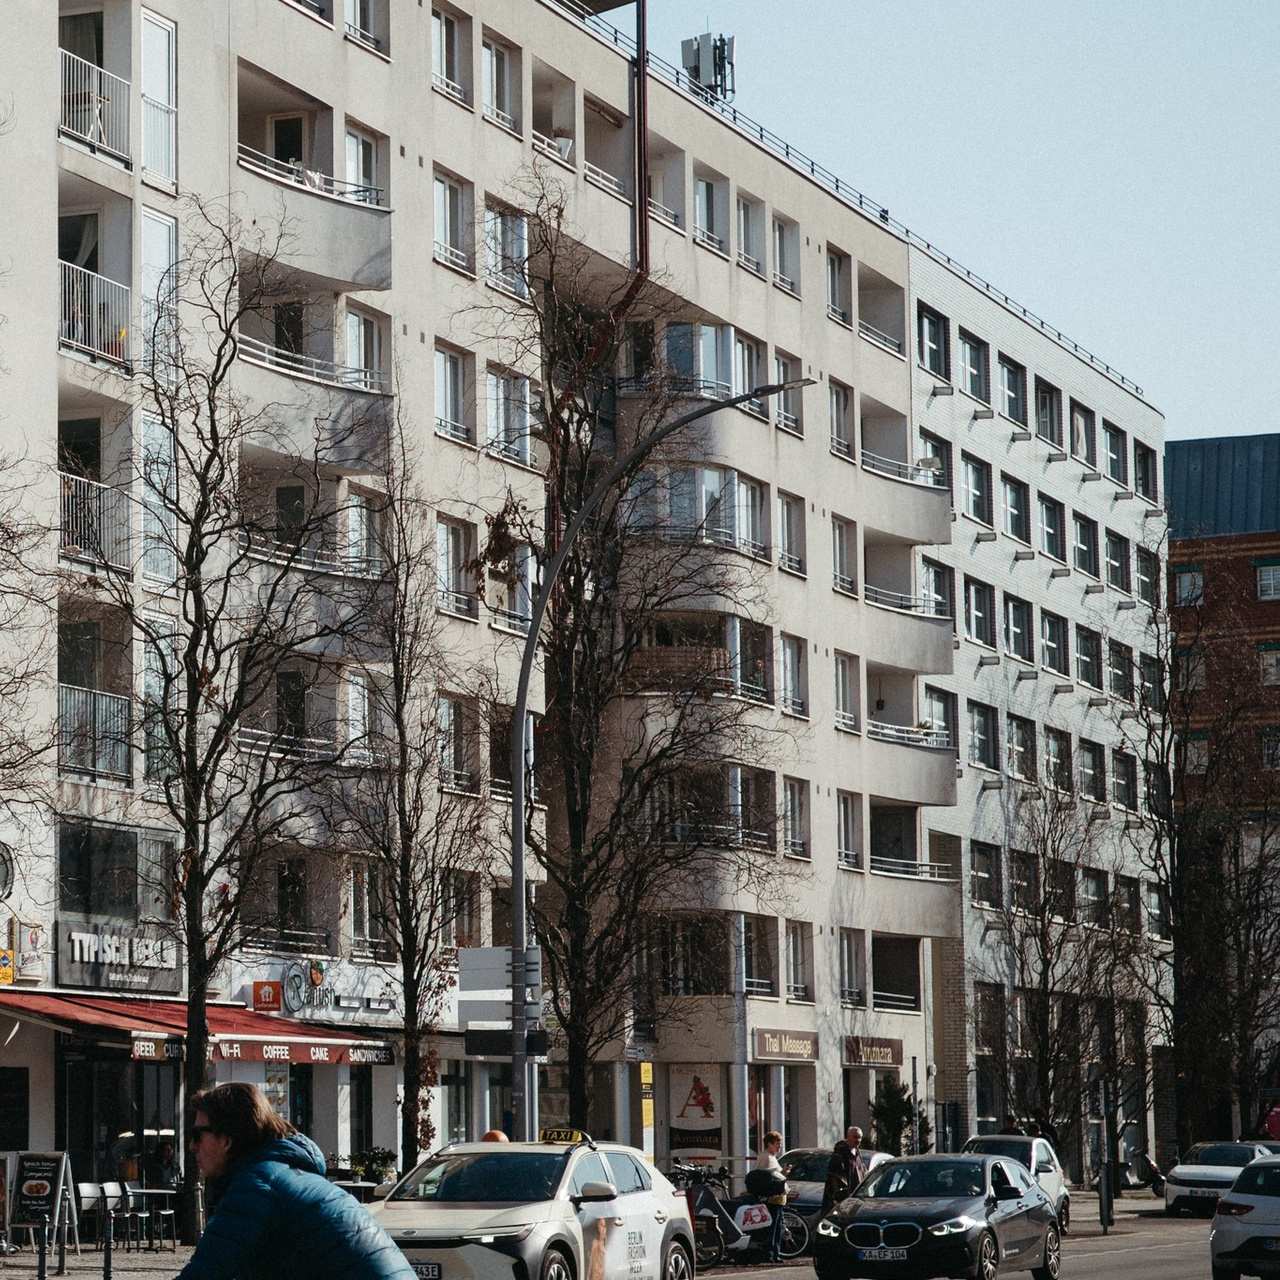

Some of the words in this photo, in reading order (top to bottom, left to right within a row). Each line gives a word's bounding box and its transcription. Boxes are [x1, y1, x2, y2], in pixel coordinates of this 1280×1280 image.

[70, 931, 129, 965] TYPISCH
[132, 937, 177, 969] BERLIN
[134, 1041, 155, 1057] BEER
[220, 1043, 241, 1058] Wi-Fi
[263, 1045, 290, 1060] COFFEE
[310, 1047, 329, 1061] CAKE
[349, 1048, 390, 1063] SANDWICHES
[764, 1033, 779, 1052] Thai
[782, 1034, 812, 1058] Massage
[545, 1131, 571, 1140] TAXI
[628, 1231, 643, 1245] BERLIN
[628, 1245, 647, 1259] FASHION
[890, 1250, 906, 1259] 104
